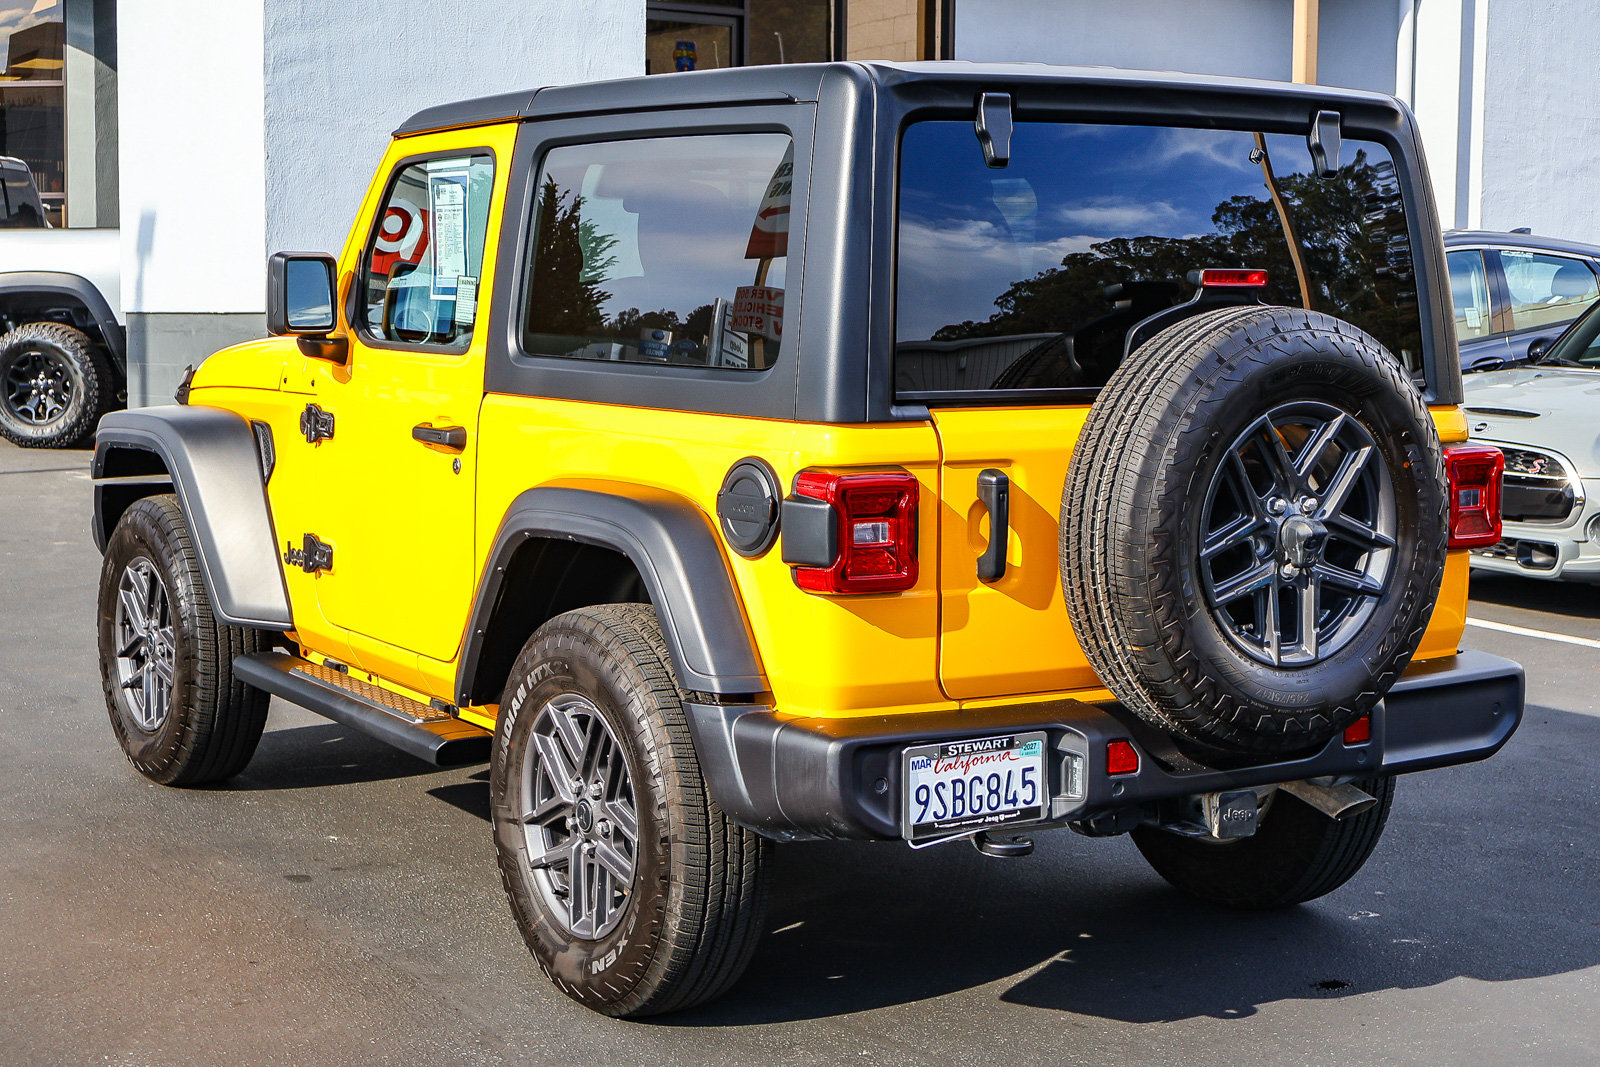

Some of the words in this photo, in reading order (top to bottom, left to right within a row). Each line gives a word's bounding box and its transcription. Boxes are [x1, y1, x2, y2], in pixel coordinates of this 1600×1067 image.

[283, 541, 305, 568] Jee
[948, 738, 1010, 756] STEWART
[1023, 742, 1037, 751] 2027
[911, 758, 932, 771] MAR
[934, 751, 1020, 775] California
[915, 766, 1037, 823] 9SBG845
[1223, 807, 1255, 822] Jeep
